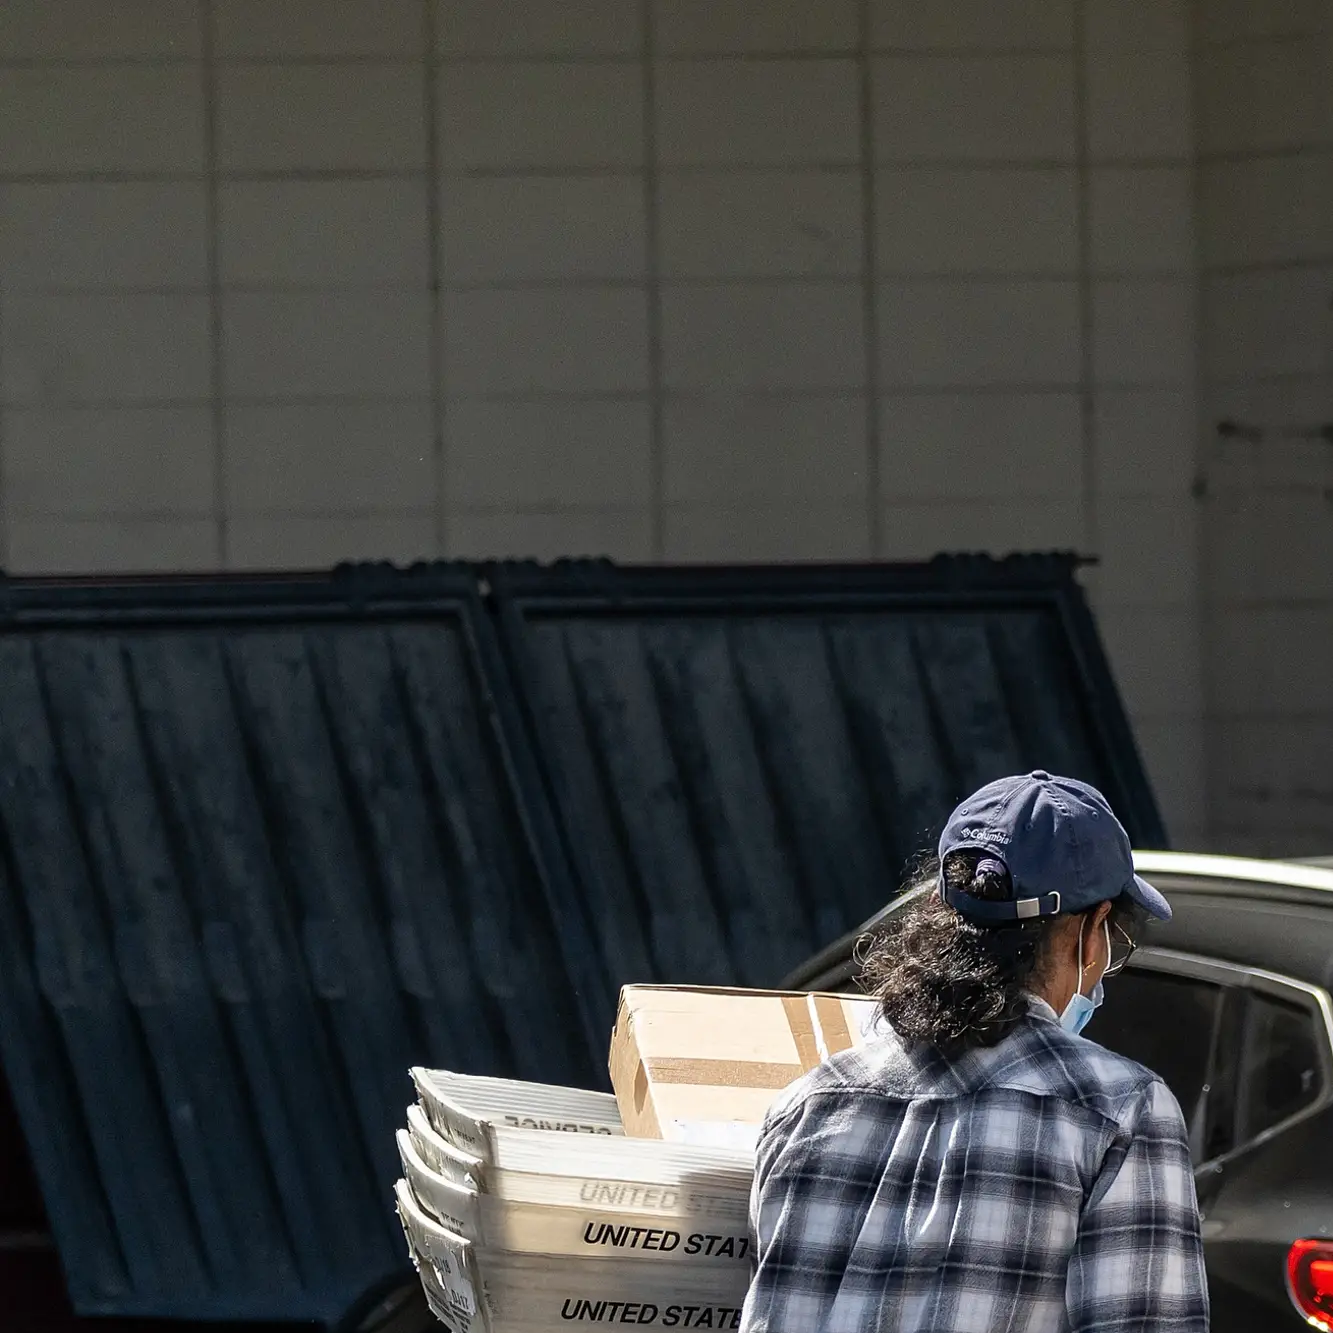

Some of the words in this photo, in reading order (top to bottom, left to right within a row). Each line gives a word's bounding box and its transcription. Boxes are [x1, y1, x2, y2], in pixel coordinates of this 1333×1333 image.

[971, 828, 1009, 845] Columbia
[580, 1182, 678, 1210] UNITED
[584, 1222, 680, 1252] UNITED
[561, 1298, 659, 1325] UNITED
